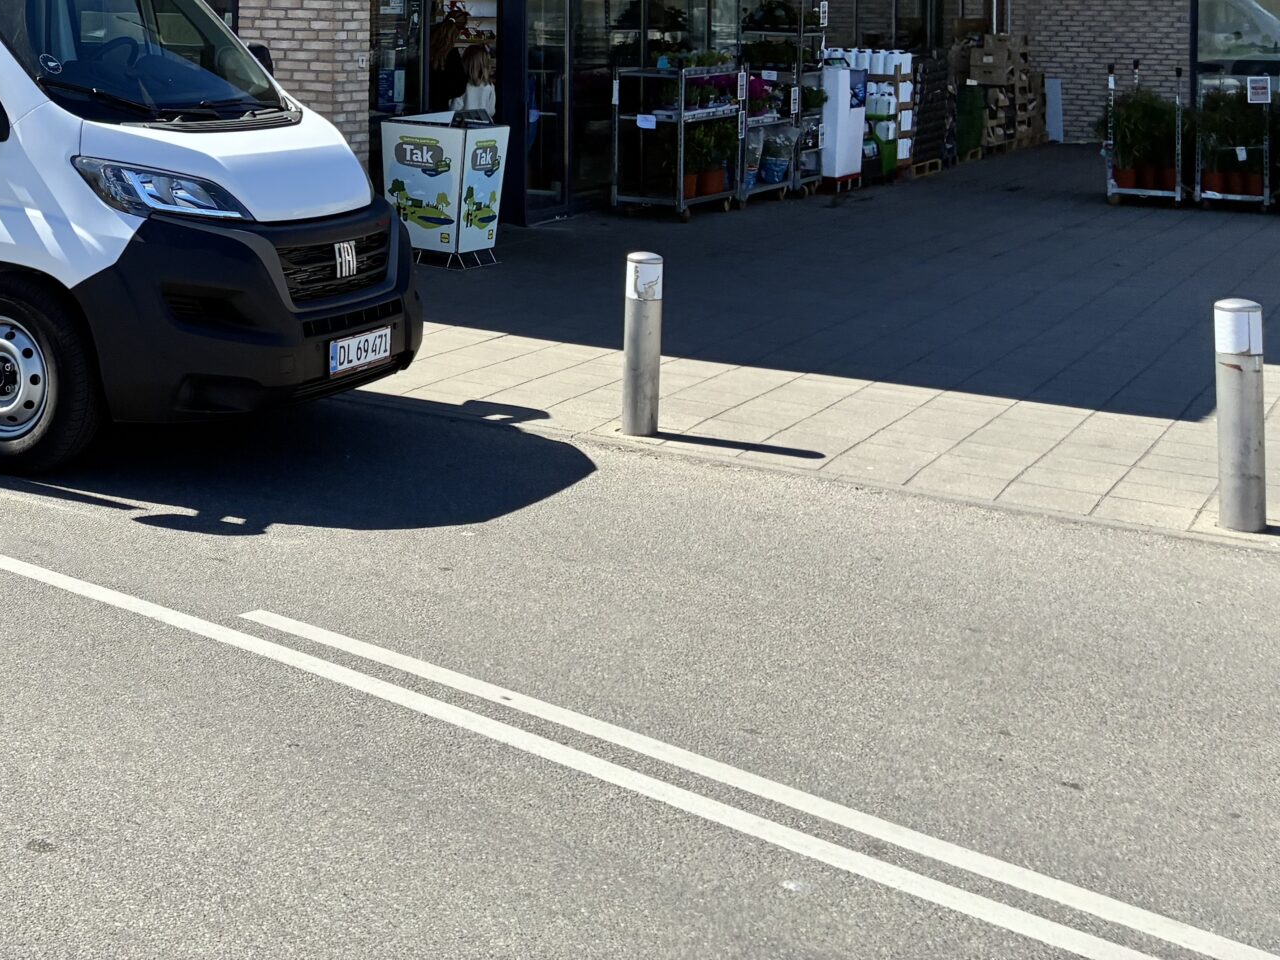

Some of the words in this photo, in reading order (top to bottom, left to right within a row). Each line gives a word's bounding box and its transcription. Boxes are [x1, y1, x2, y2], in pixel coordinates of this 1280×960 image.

[402, 144, 434, 164] Tak
[476, 147, 493, 165] Tak
[334, 240, 357, 279] FIAT
[338, 345, 353, 366] DL
[355, 338, 369, 361] 69
[371, 333, 389, 356] 471
